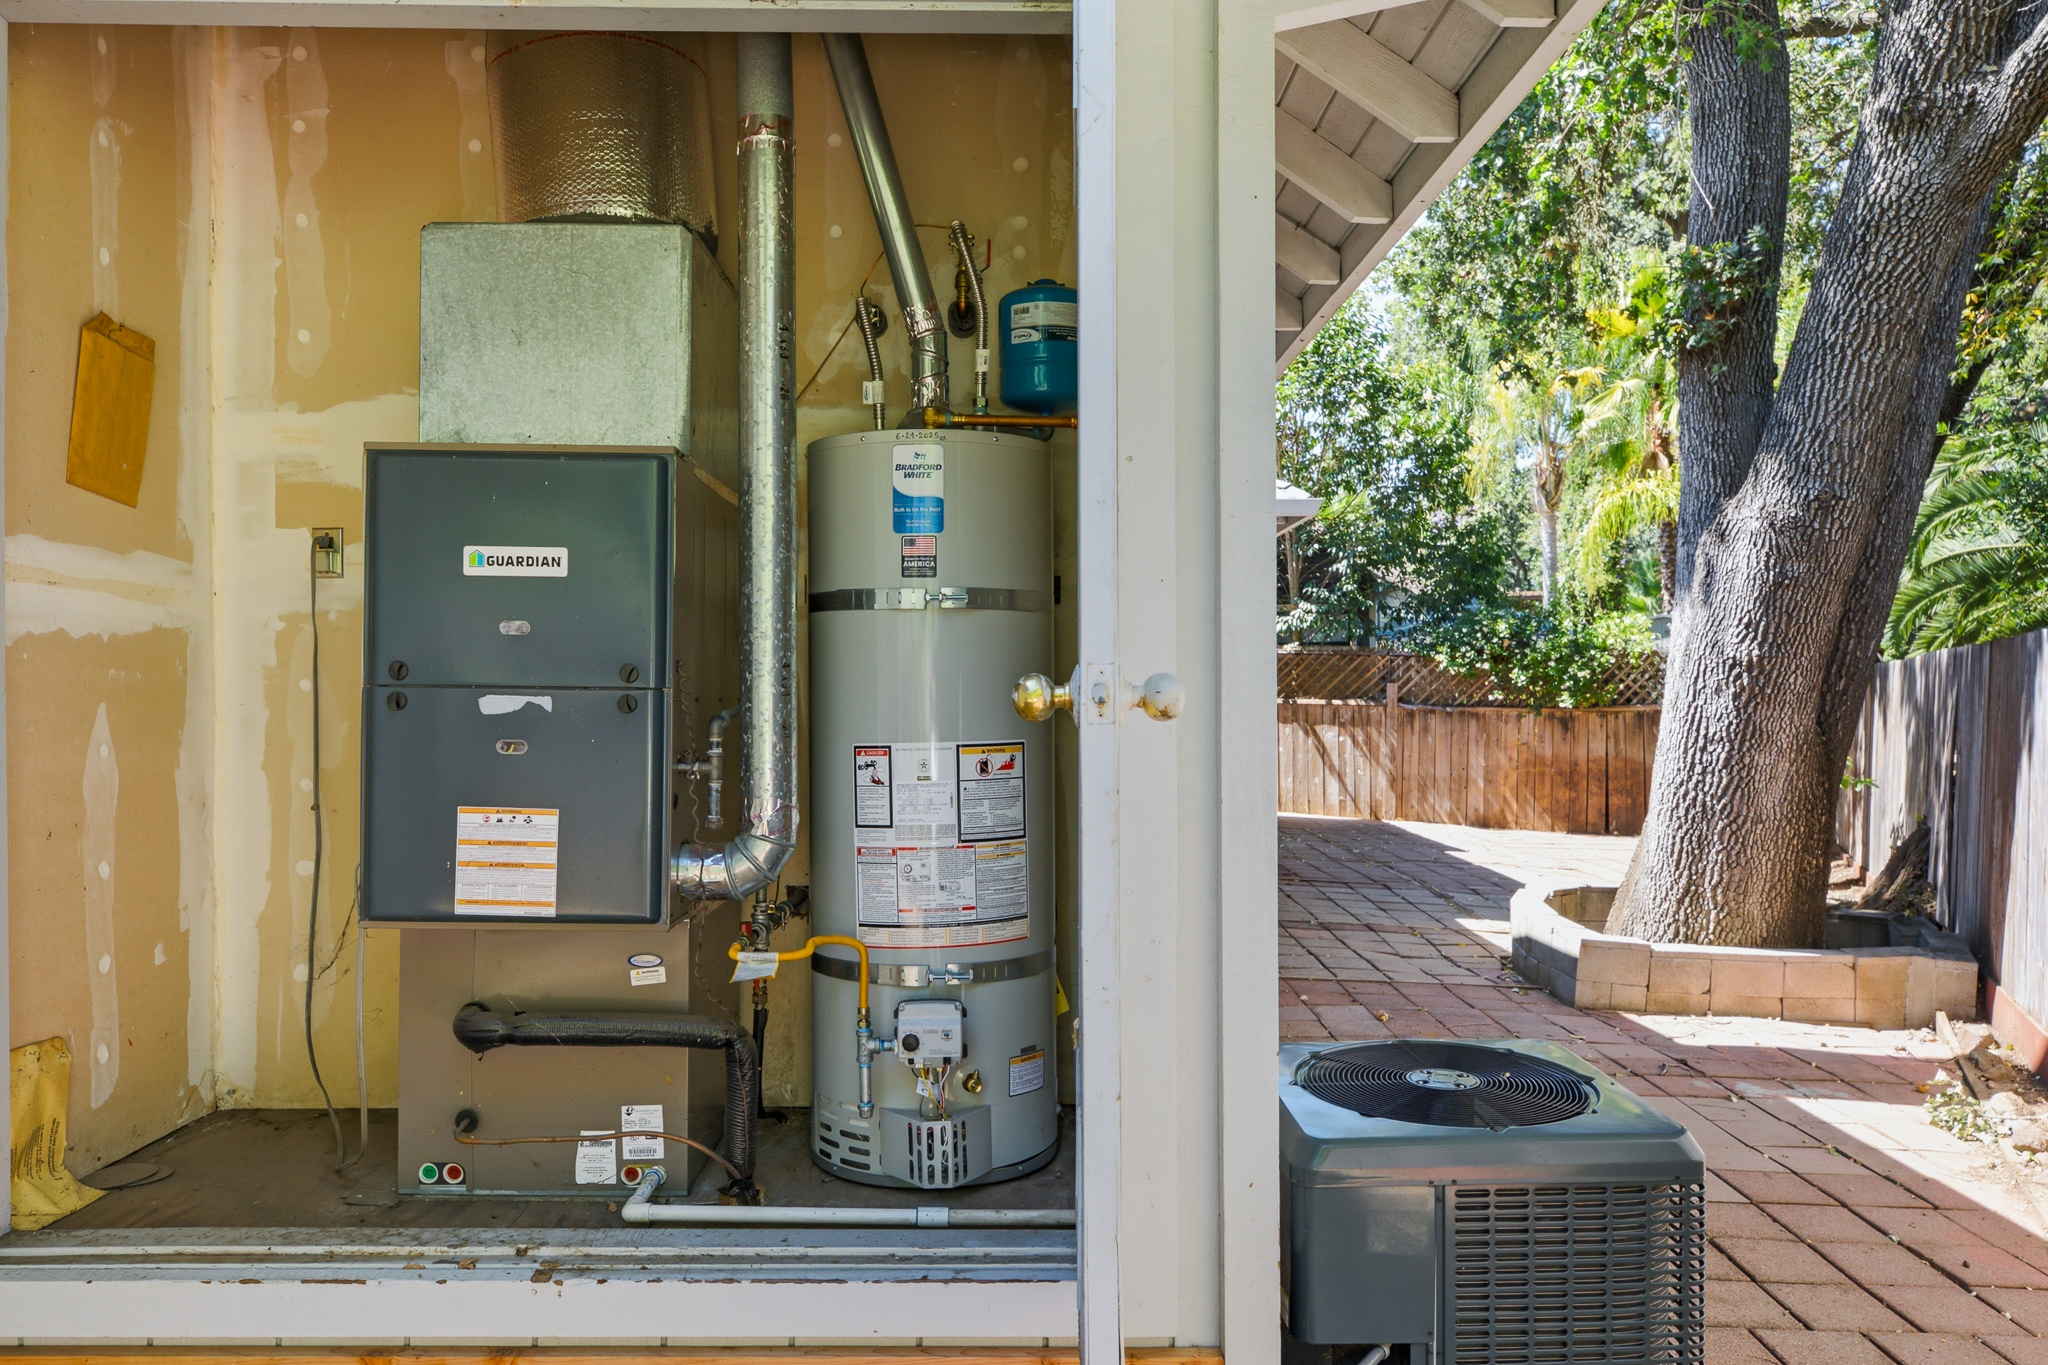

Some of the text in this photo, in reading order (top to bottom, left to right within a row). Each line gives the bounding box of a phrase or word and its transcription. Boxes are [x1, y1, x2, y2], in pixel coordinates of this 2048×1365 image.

[895, 463, 942, 471] BRADFORD
[904, 471, 932, 479] WHITE
[486, 556, 561, 568] GUARDIAN
